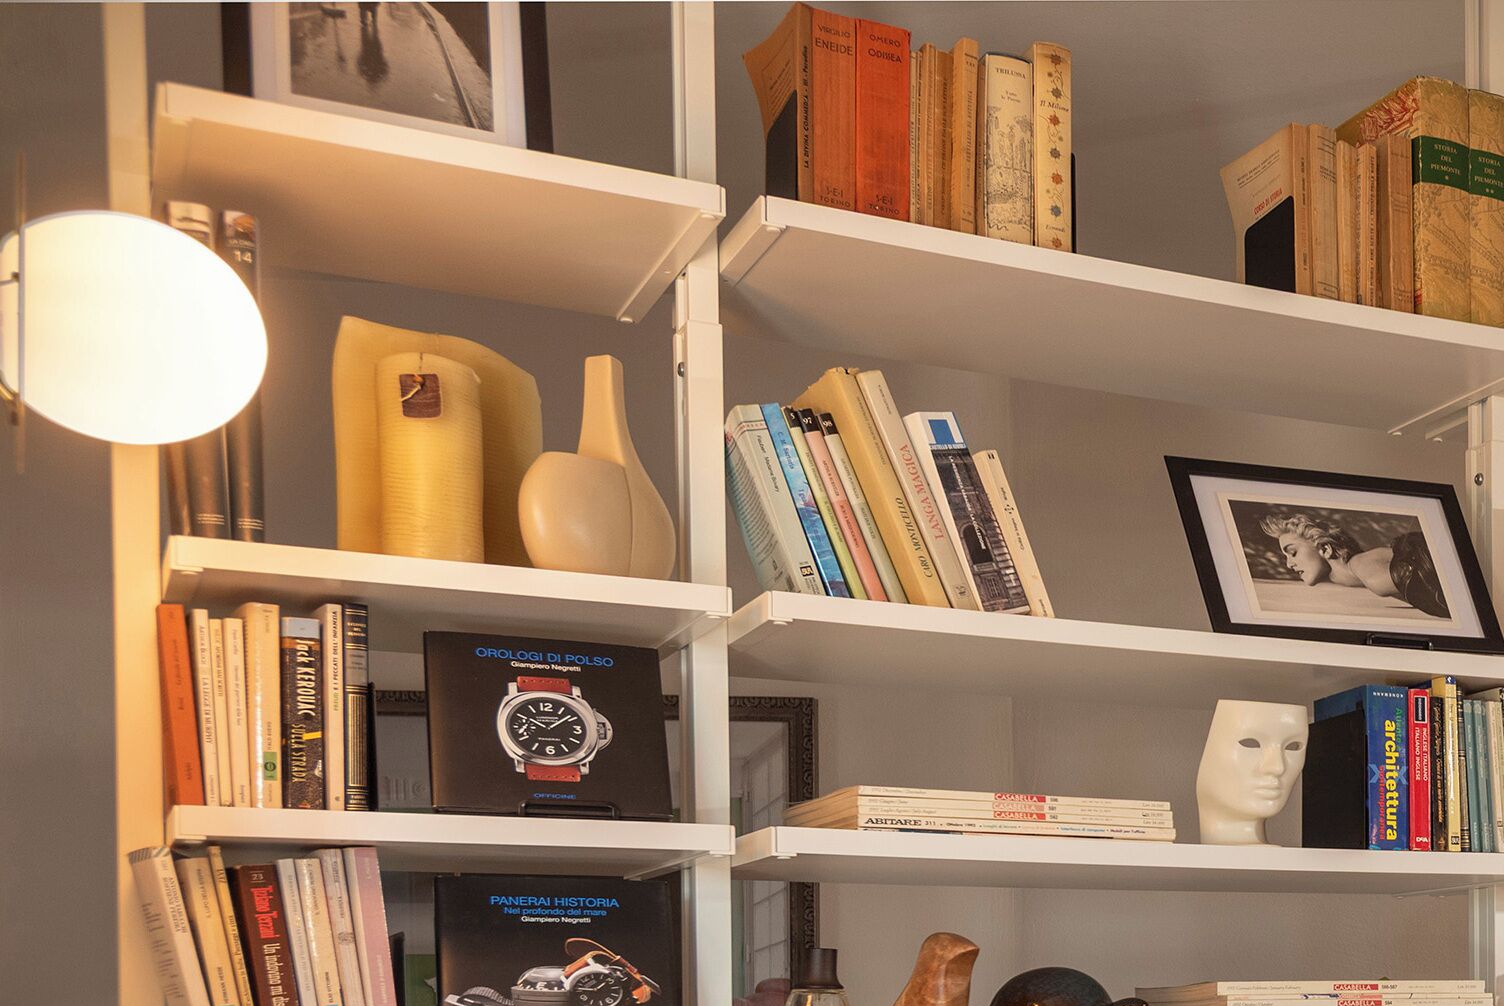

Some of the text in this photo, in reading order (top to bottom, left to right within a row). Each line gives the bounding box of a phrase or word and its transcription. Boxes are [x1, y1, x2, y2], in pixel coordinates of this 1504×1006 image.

[818, 24, 850, 39] VIRGILIO
[869, 34, 901, 47] OMERO
[814, 38, 854, 57] ENEIDE
[868, 48, 902, 64] ODISSEA
[1433, 143, 1458, 154] STORIA
[1440, 154, 1452, 163] DEL
[1477, 155, 1501, 167] STORIA
[1430, 163, 1462, 176] PIEMONTE
[1483, 166, 1496, 176] DEL
[1474, 174, 1504, 188] PIEMONTE
[803, 417, 813, 425] 97
[899, 444, 945, 541] LANGA MAGICA
[896, 497, 921, 551] MONTICELLO
[475, 647, 614, 667] OROLOGI DI POLSO
[510, 660, 581, 673] Giampiero Negretti
[296, 640, 316, 716] Jack KEROUAC
[539, 702, 553, 712] 12
[573, 725, 582, 735] 3
[291, 724, 306, 783] SULLA STRADA
[546, 745, 555, 755] 6
[1385, 719, 1400, 840] architettura
[864, 817, 922, 826] ABITARE
[994, 811, 1037, 820] CASABELLA
[489, 895, 620, 908] PANERAI HISTORIA
[250, 885, 280, 939] Tiziano Terzani
[504, 907, 521, 915] Nel
[522, 907, 565, 916] profondo
[567, 907, 582, 915] del
[521, 916, 591, 924] Giampiero Negretti
[262, 943, 281, 954] Un
[264, 955, 284, 985] indovino
[270, 986, 288, 996] mi
